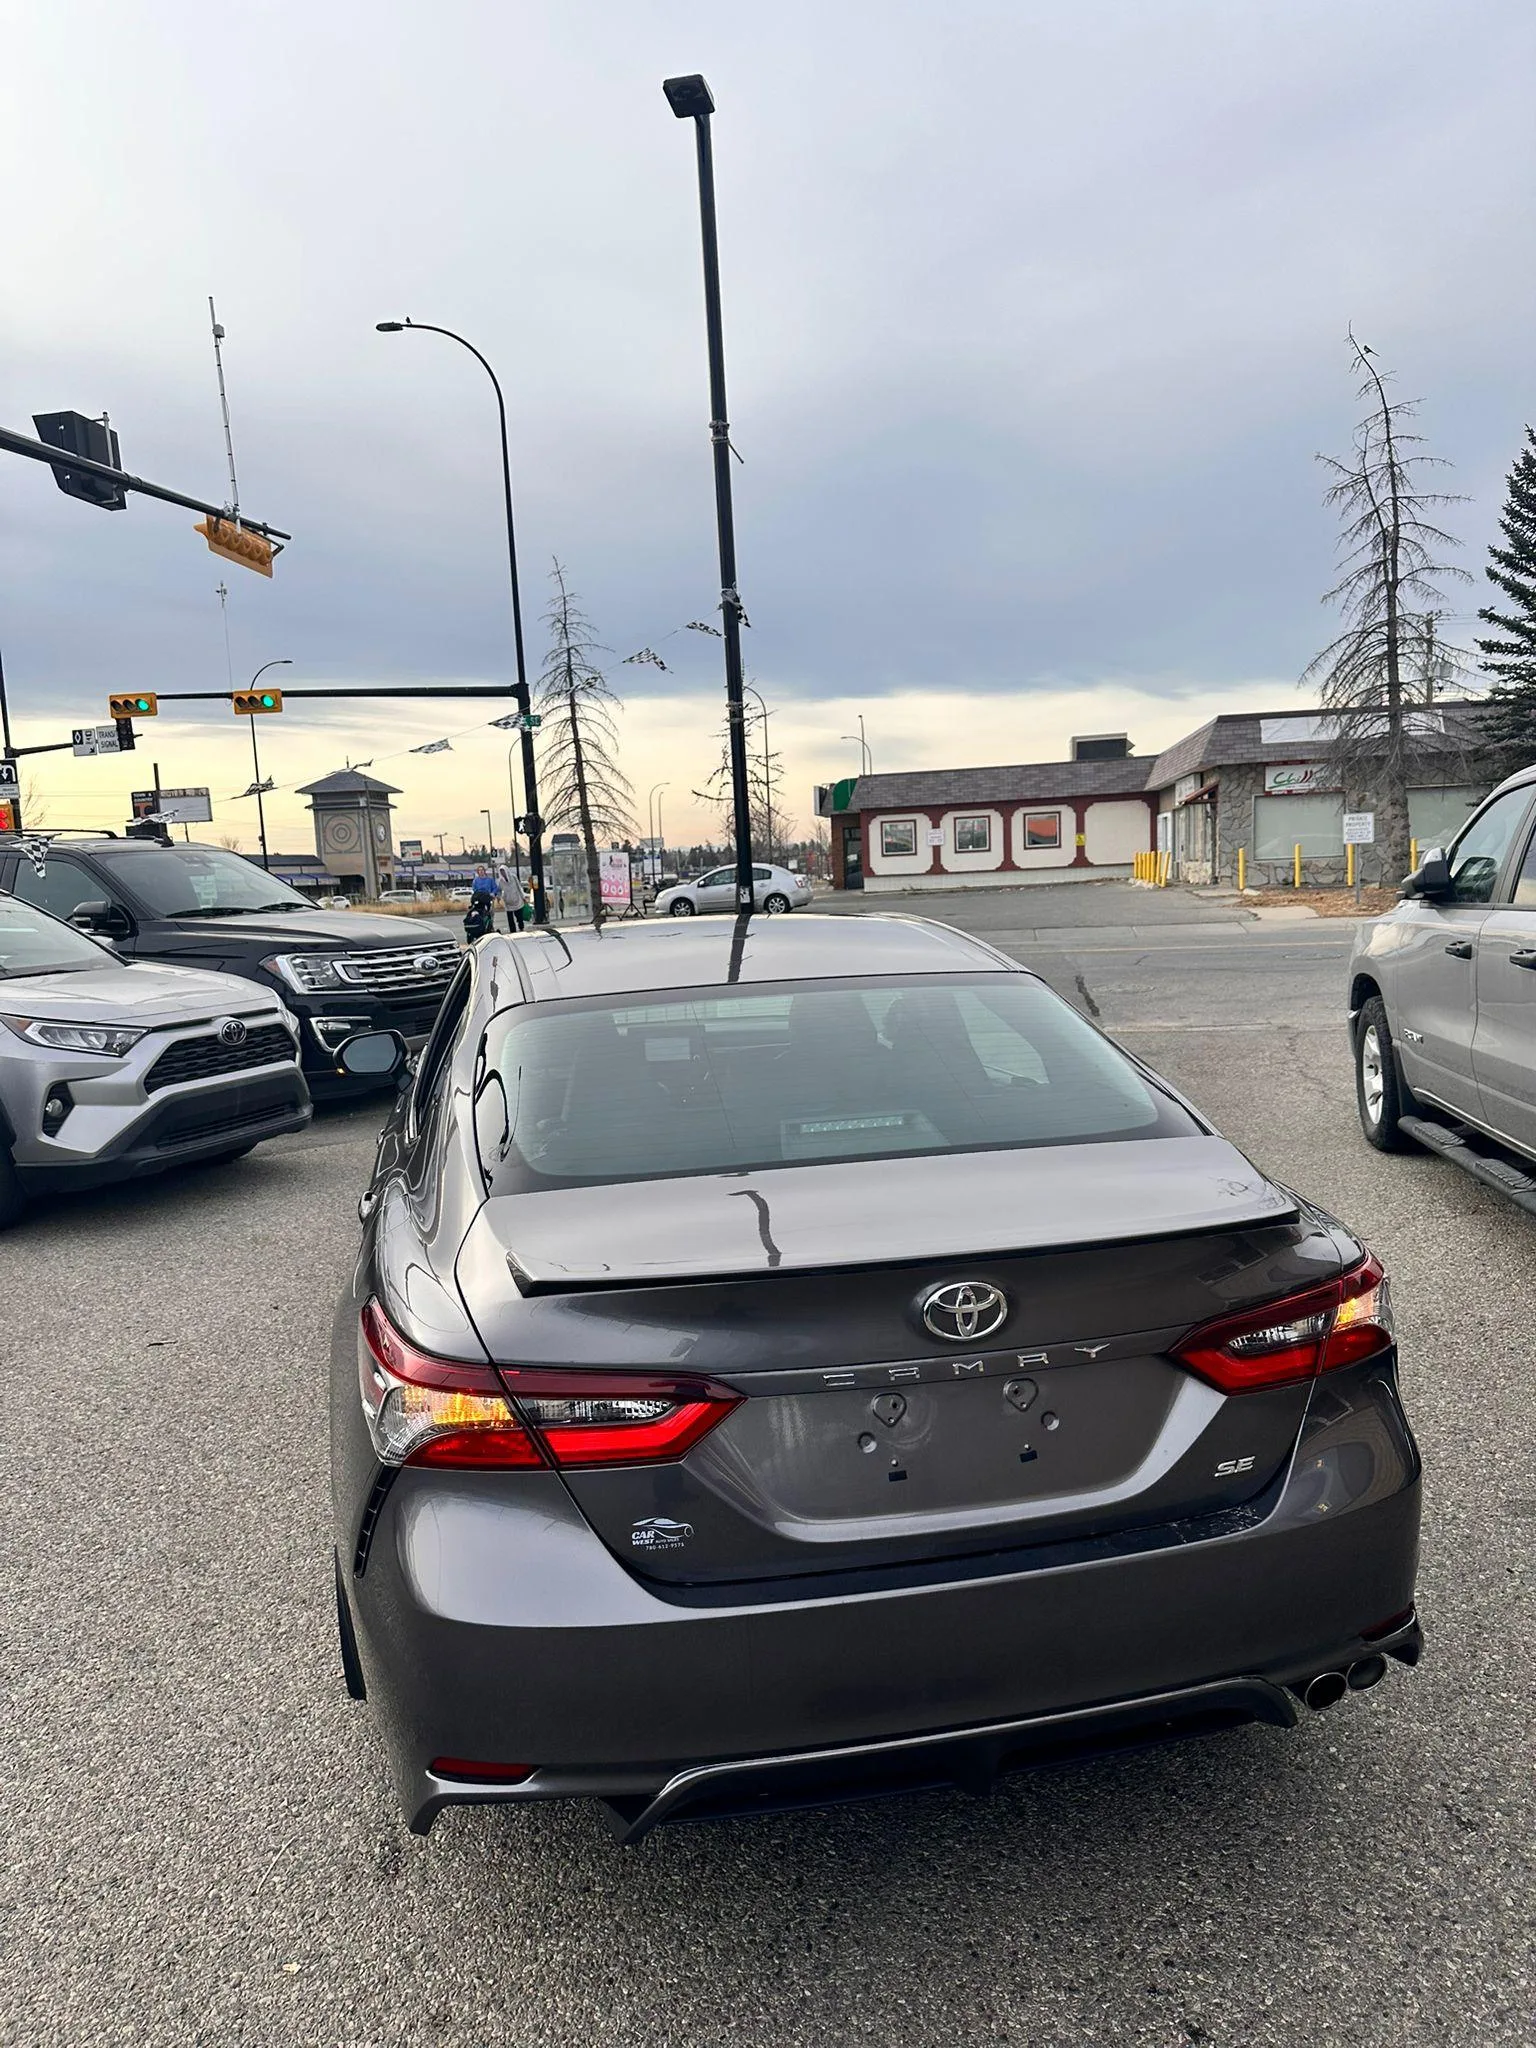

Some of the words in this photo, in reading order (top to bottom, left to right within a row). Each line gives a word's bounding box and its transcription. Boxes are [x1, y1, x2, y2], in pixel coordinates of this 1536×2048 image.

[823, 1343, 1110, 1387] CAMRY
[1214, 1455, 1256, 1478] SE
[632, 1531, 655, 1540] CAR
